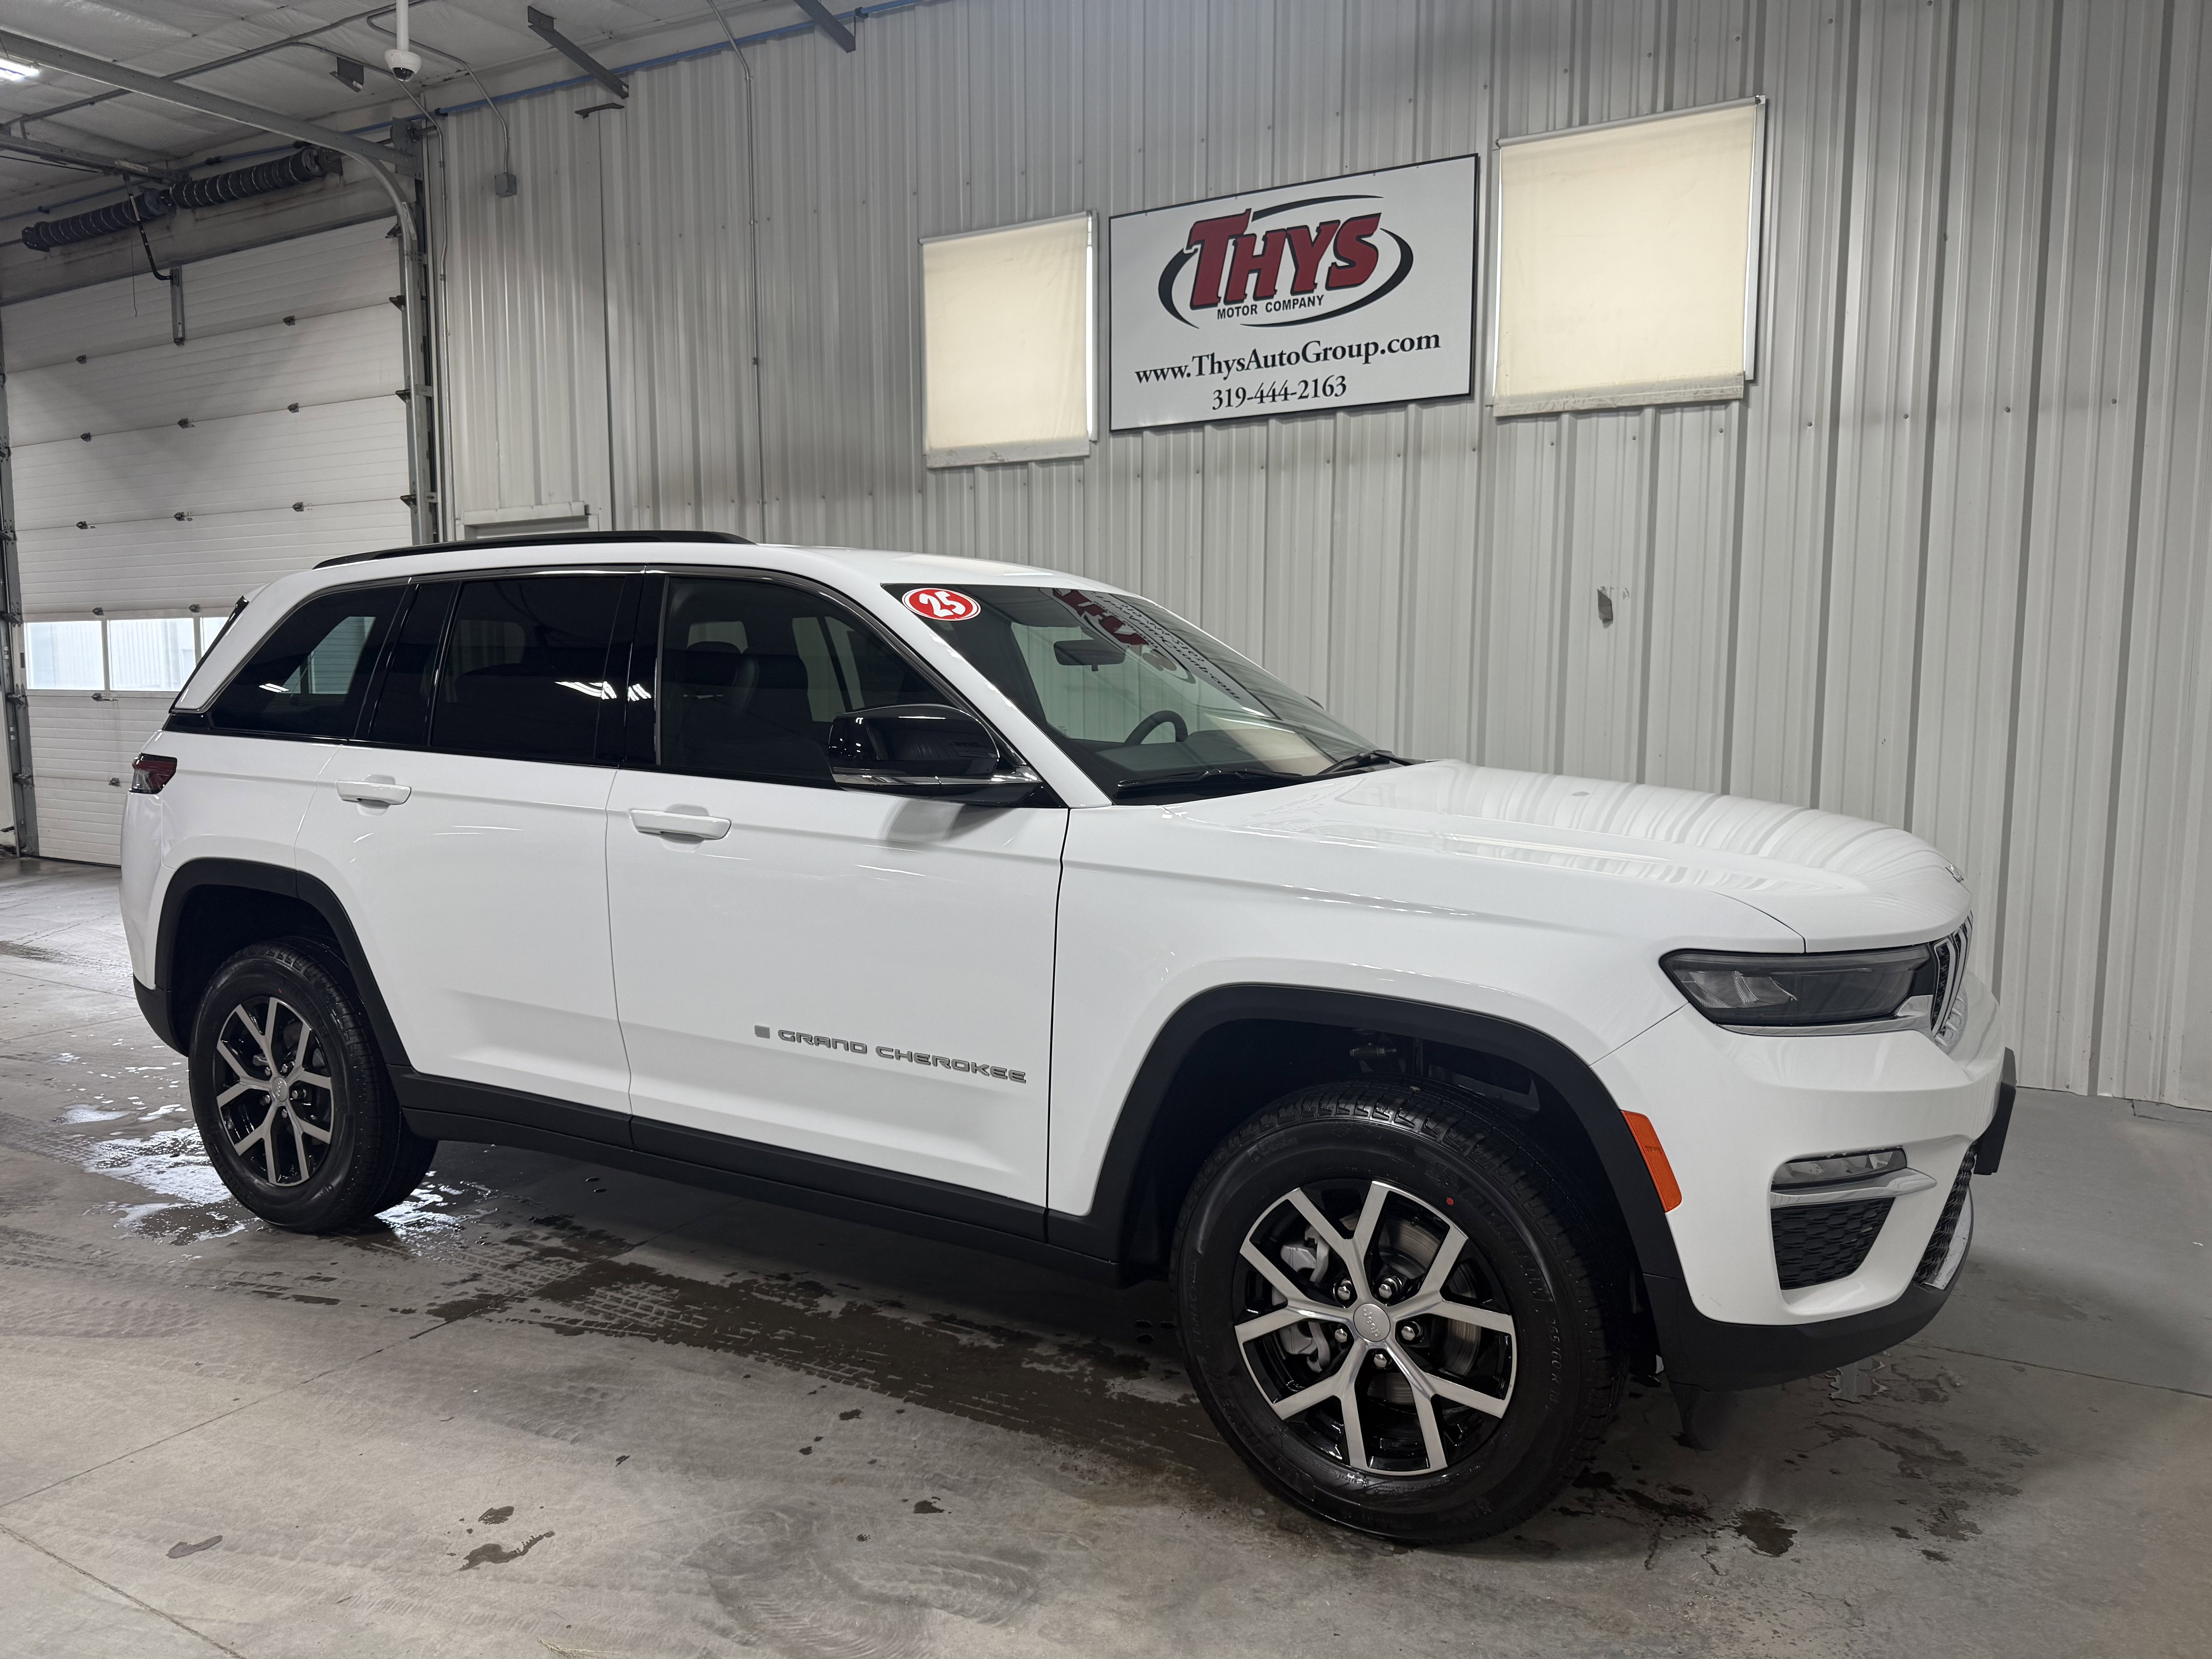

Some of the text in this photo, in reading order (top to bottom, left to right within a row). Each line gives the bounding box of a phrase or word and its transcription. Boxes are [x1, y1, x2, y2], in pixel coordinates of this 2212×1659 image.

[1187, 208, 1381, 310] THYS
[1217, 295, 1324, 320] MOTOR COMPANY
[1135, 333, 1441, 383] www.ThysAutoGroup.com
[1212, 376, 1346, 410] 319-444-2163
[919, 591, 966, 617] 25
[778, 1030, 1026, 1084] GRAND CHEROKEE
[1363, 1309, 1380, 1336] Jeep
